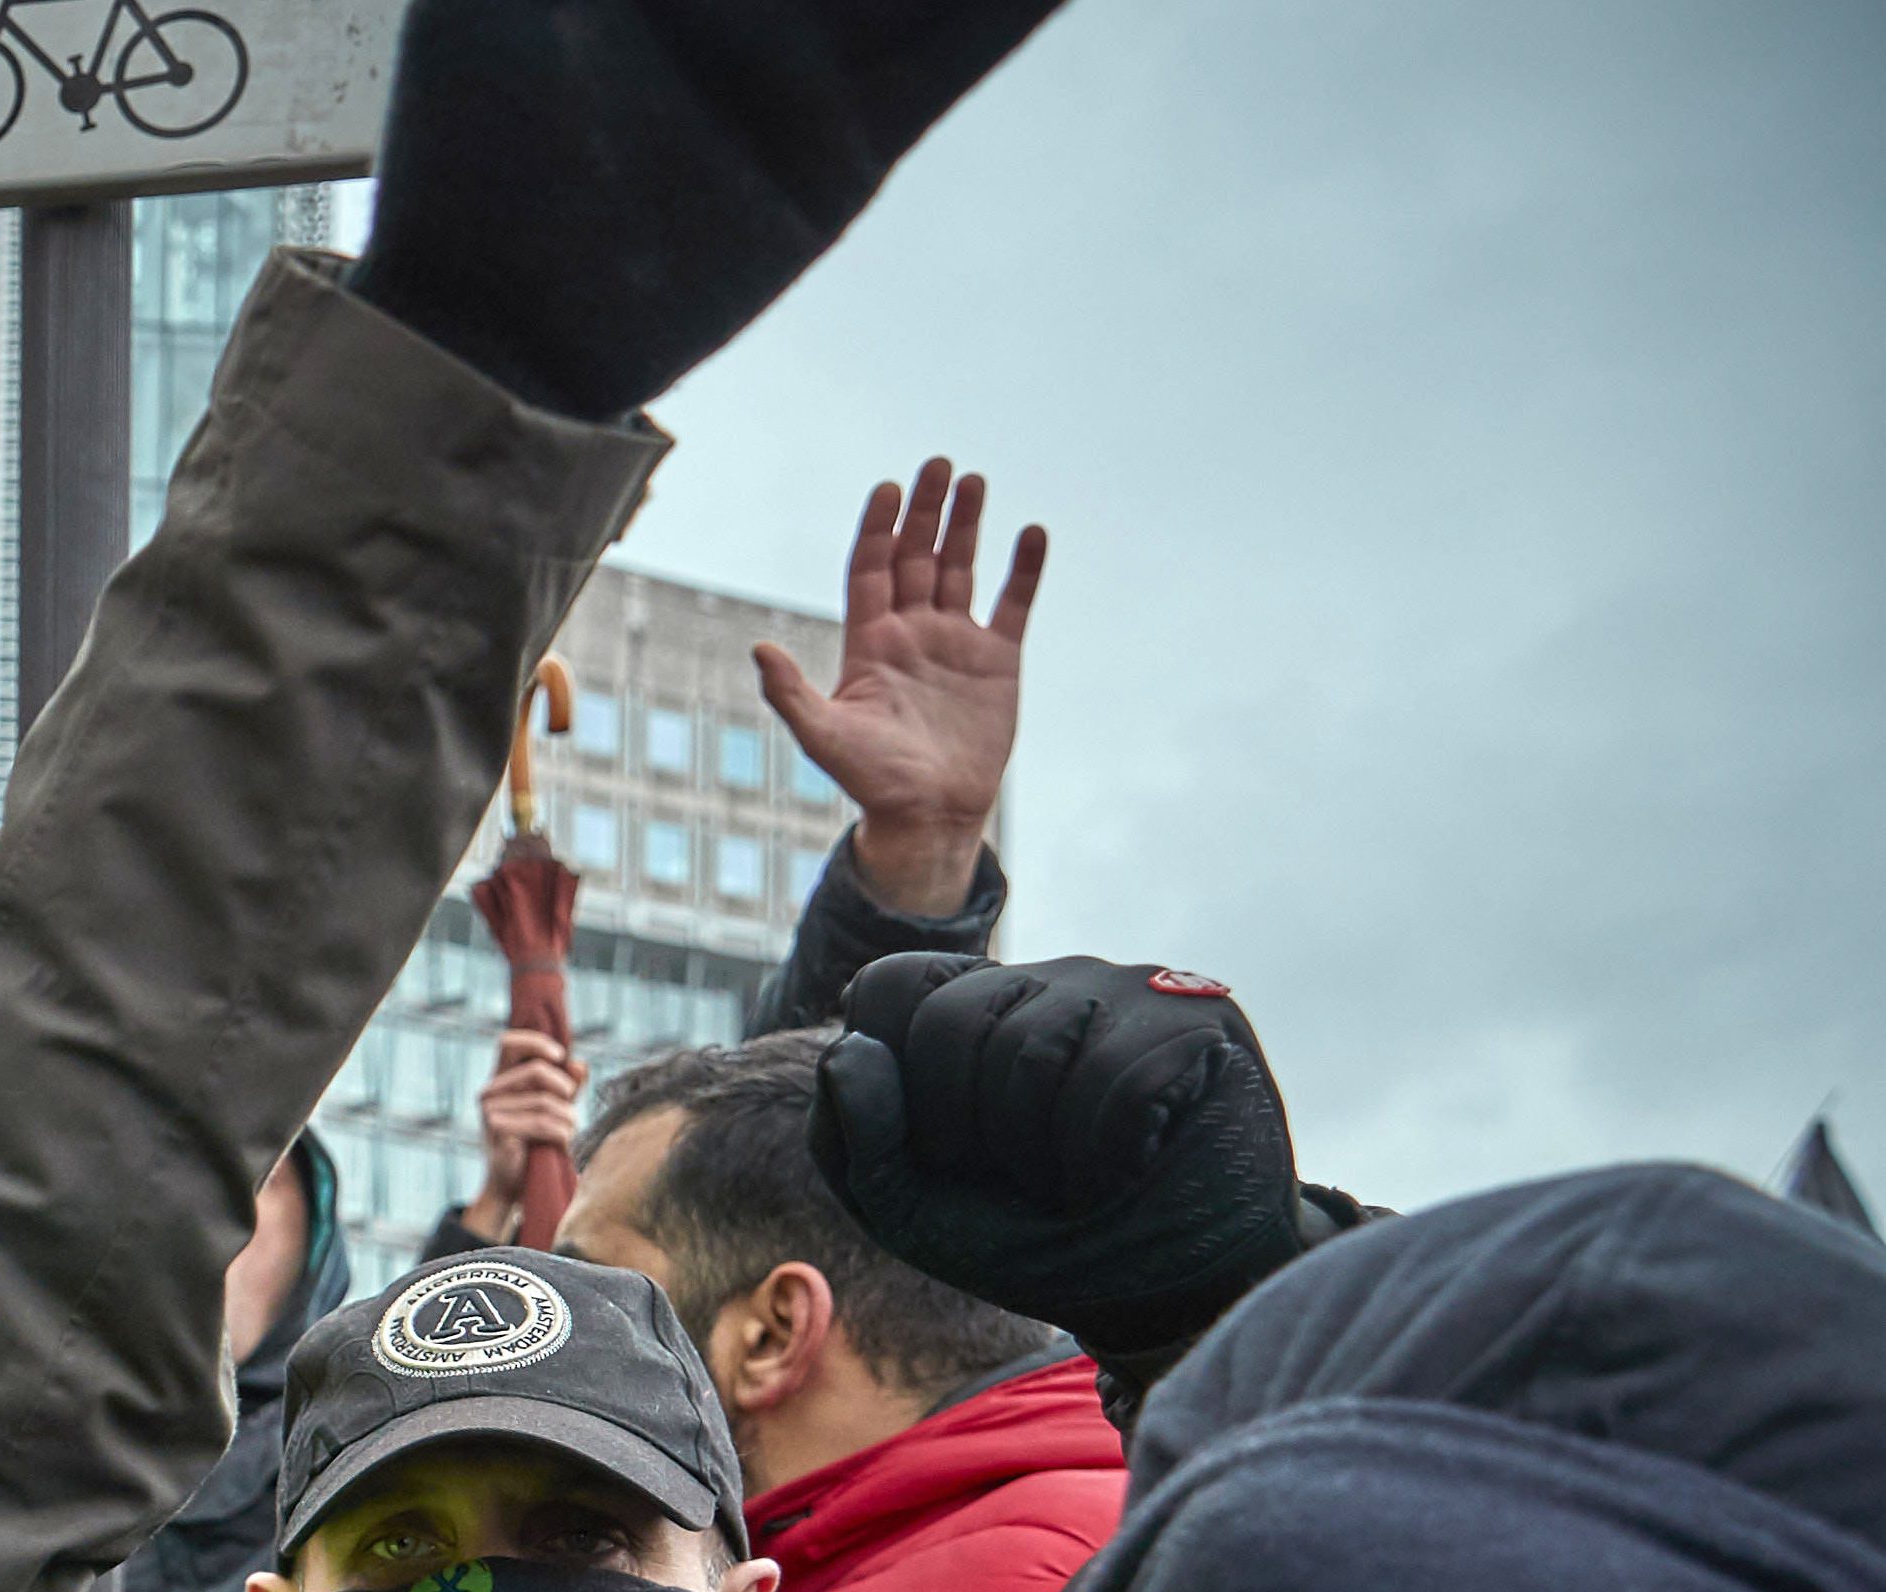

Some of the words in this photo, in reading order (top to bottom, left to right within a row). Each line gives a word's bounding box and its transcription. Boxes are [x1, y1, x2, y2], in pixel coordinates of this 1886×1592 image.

[407, 1269, 529, 1306] AMSTERDAM
[390, 1316, 467, 1363] AMSTERDAM
[424, 1287, 517, 1345] A
[483, 1296, 554, 1359] AMSTERDAM
